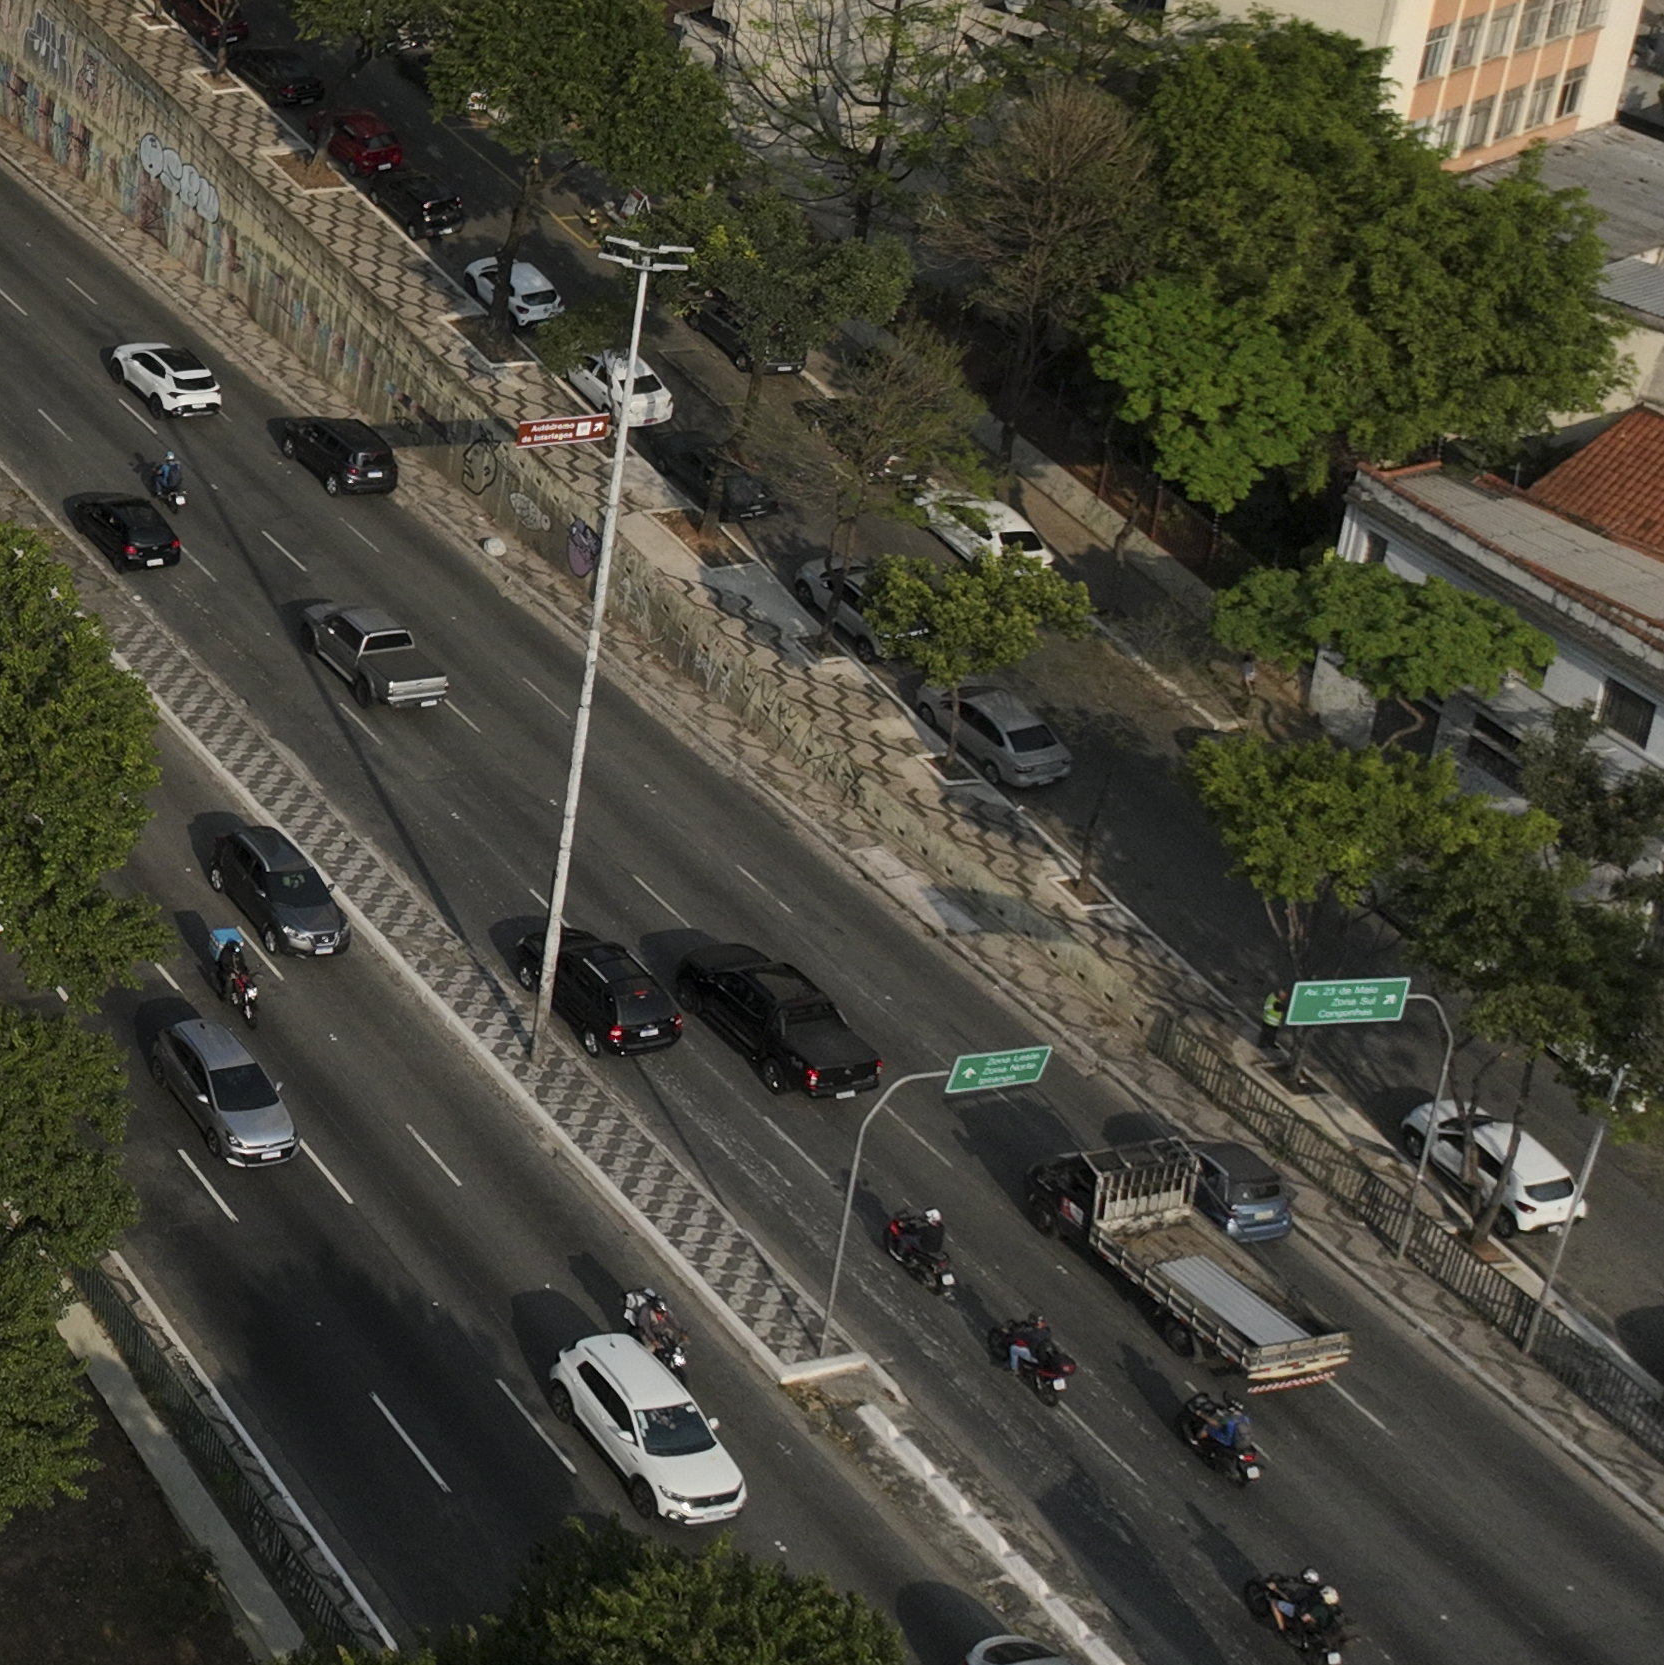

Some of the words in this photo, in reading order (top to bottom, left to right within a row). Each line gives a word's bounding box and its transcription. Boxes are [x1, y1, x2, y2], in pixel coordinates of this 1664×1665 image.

[531, 422, 575, 432] Autódromo
[521, 435, 532, 443] de
[1331, 998, 1357, 1007] Zona
[1359, 997, 1377, 1005] Sul
